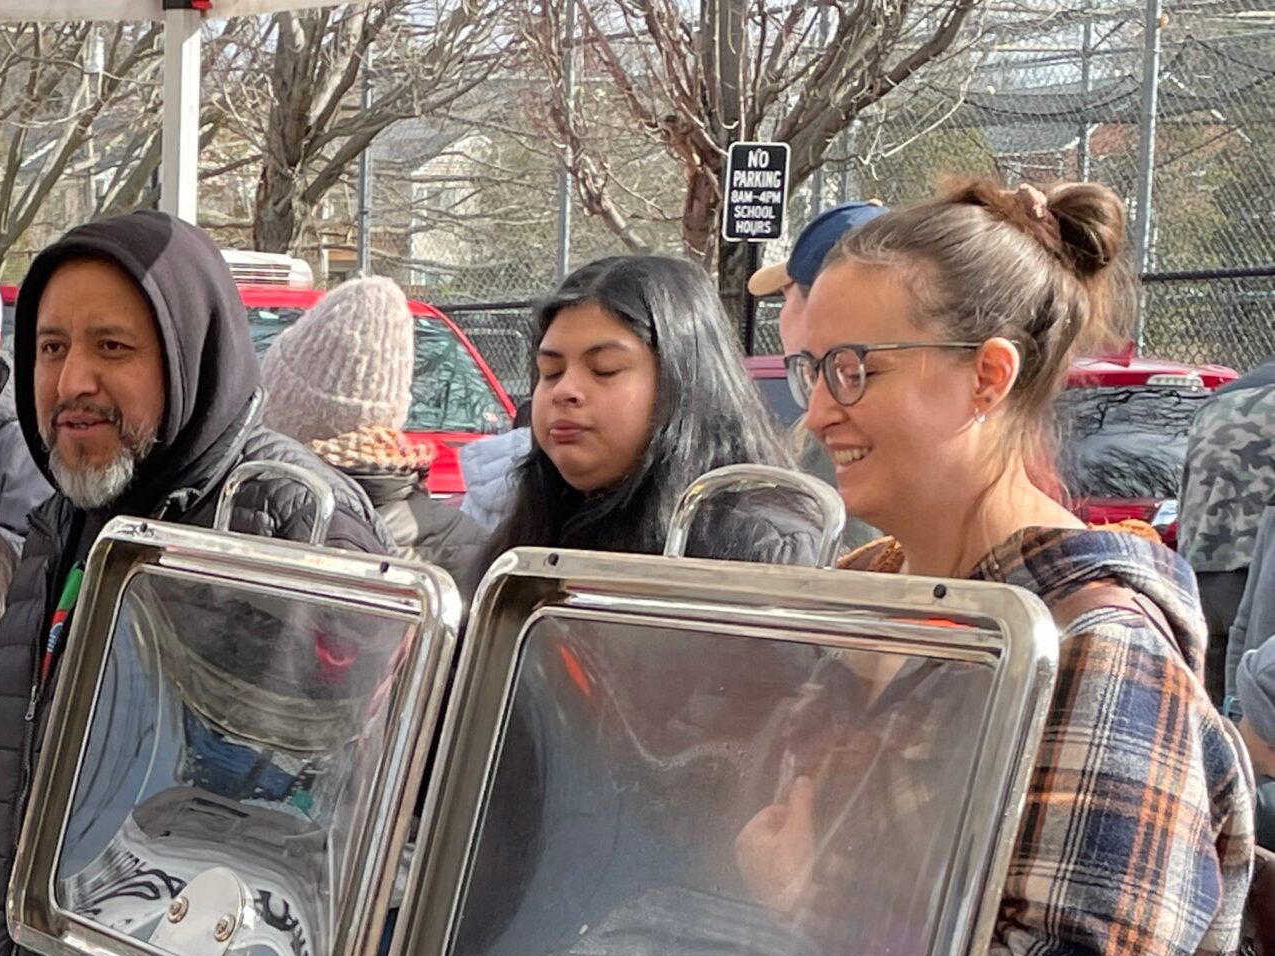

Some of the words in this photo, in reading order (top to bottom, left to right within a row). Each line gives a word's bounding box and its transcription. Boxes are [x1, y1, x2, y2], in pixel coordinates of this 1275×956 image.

[747, 149, 770, 168] NO
[733, 170, 782, 188] PARKING
[731, 190, 782, 204] 8AM-4PM
[734, 205, 776, 219] SCHOOL
[735, 221, 772, 234] HOURS
